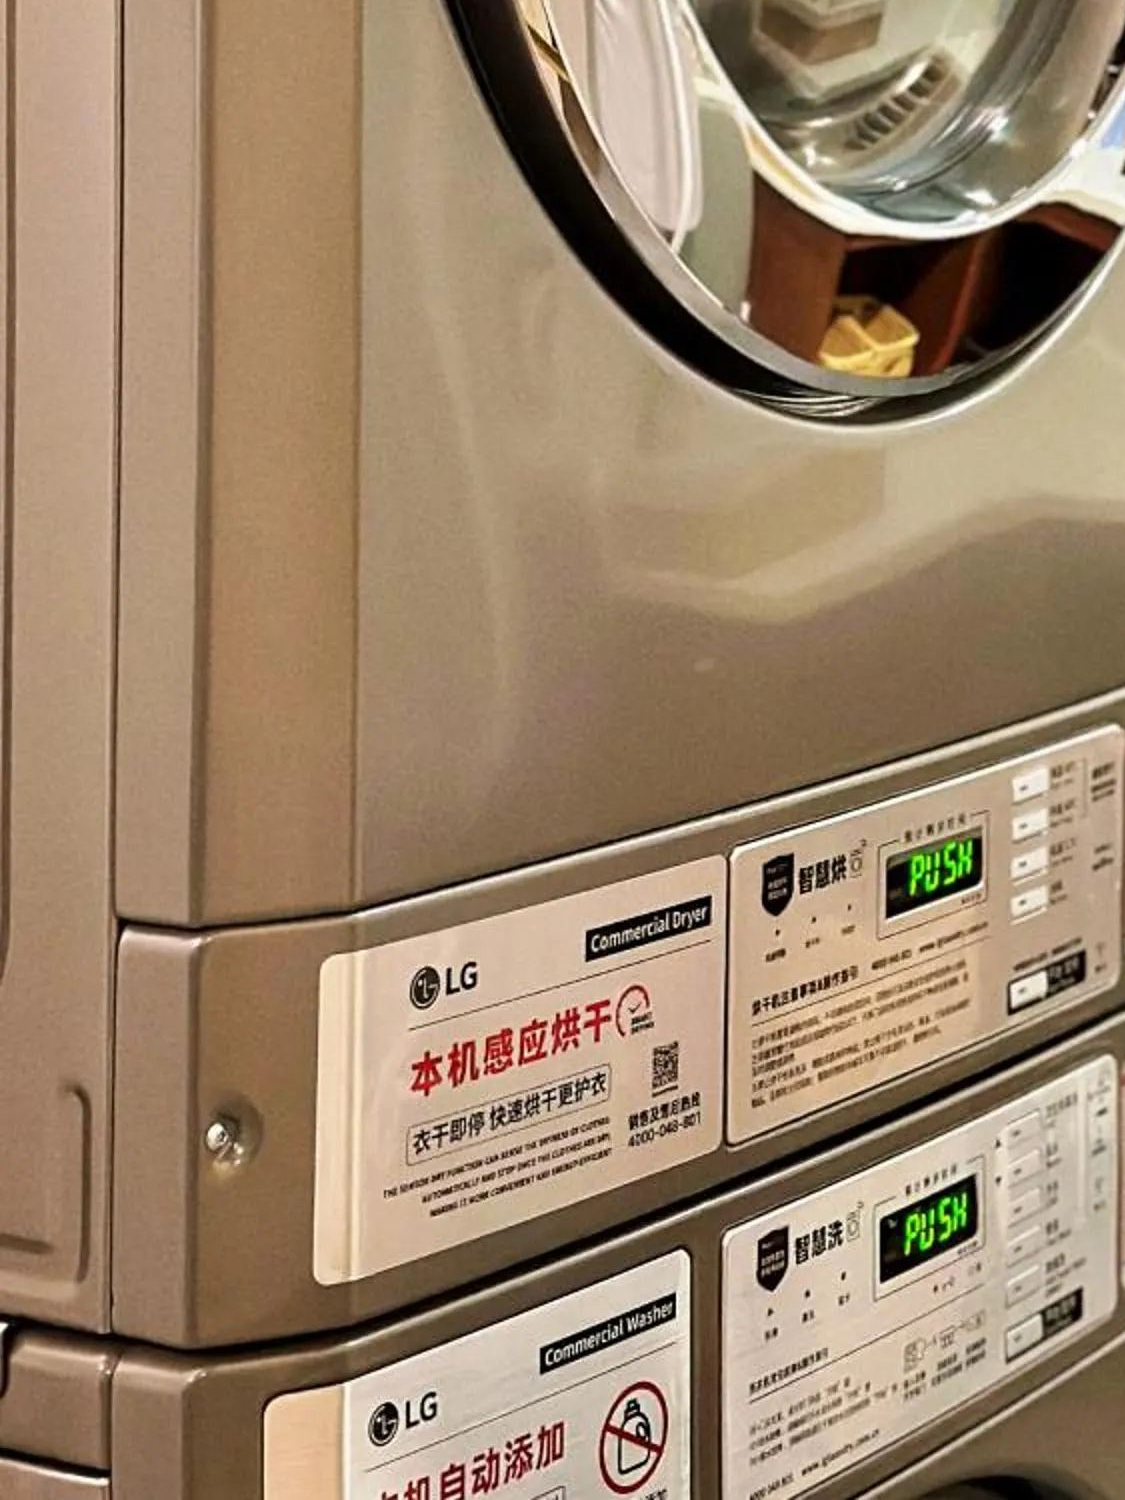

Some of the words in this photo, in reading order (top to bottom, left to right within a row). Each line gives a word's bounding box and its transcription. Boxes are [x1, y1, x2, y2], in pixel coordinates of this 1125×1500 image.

[799, 853, 847, 895] 智慧烘
[909, 838, 974, 898] PUSH
[590, 917, 669, 954] Commercial
[673, 904, 708, 931] Dryer
[446, 962, 478, 996] LG
[410, 999, 613, 1097] 本机感应烘干
[413, 1116, 485, 1155] 衣干即停
[489, 1072, 607, 1128] 快速烘干更护衣
[795, 1218, 844, 1264] 智慧洗
[904, 1191, 968, 1257] PUSH
[544, 1322, 623, 1367] Commercial
[627, 1300, 674, 1332] Washer
[405, 1391, 438, 1430] LG
